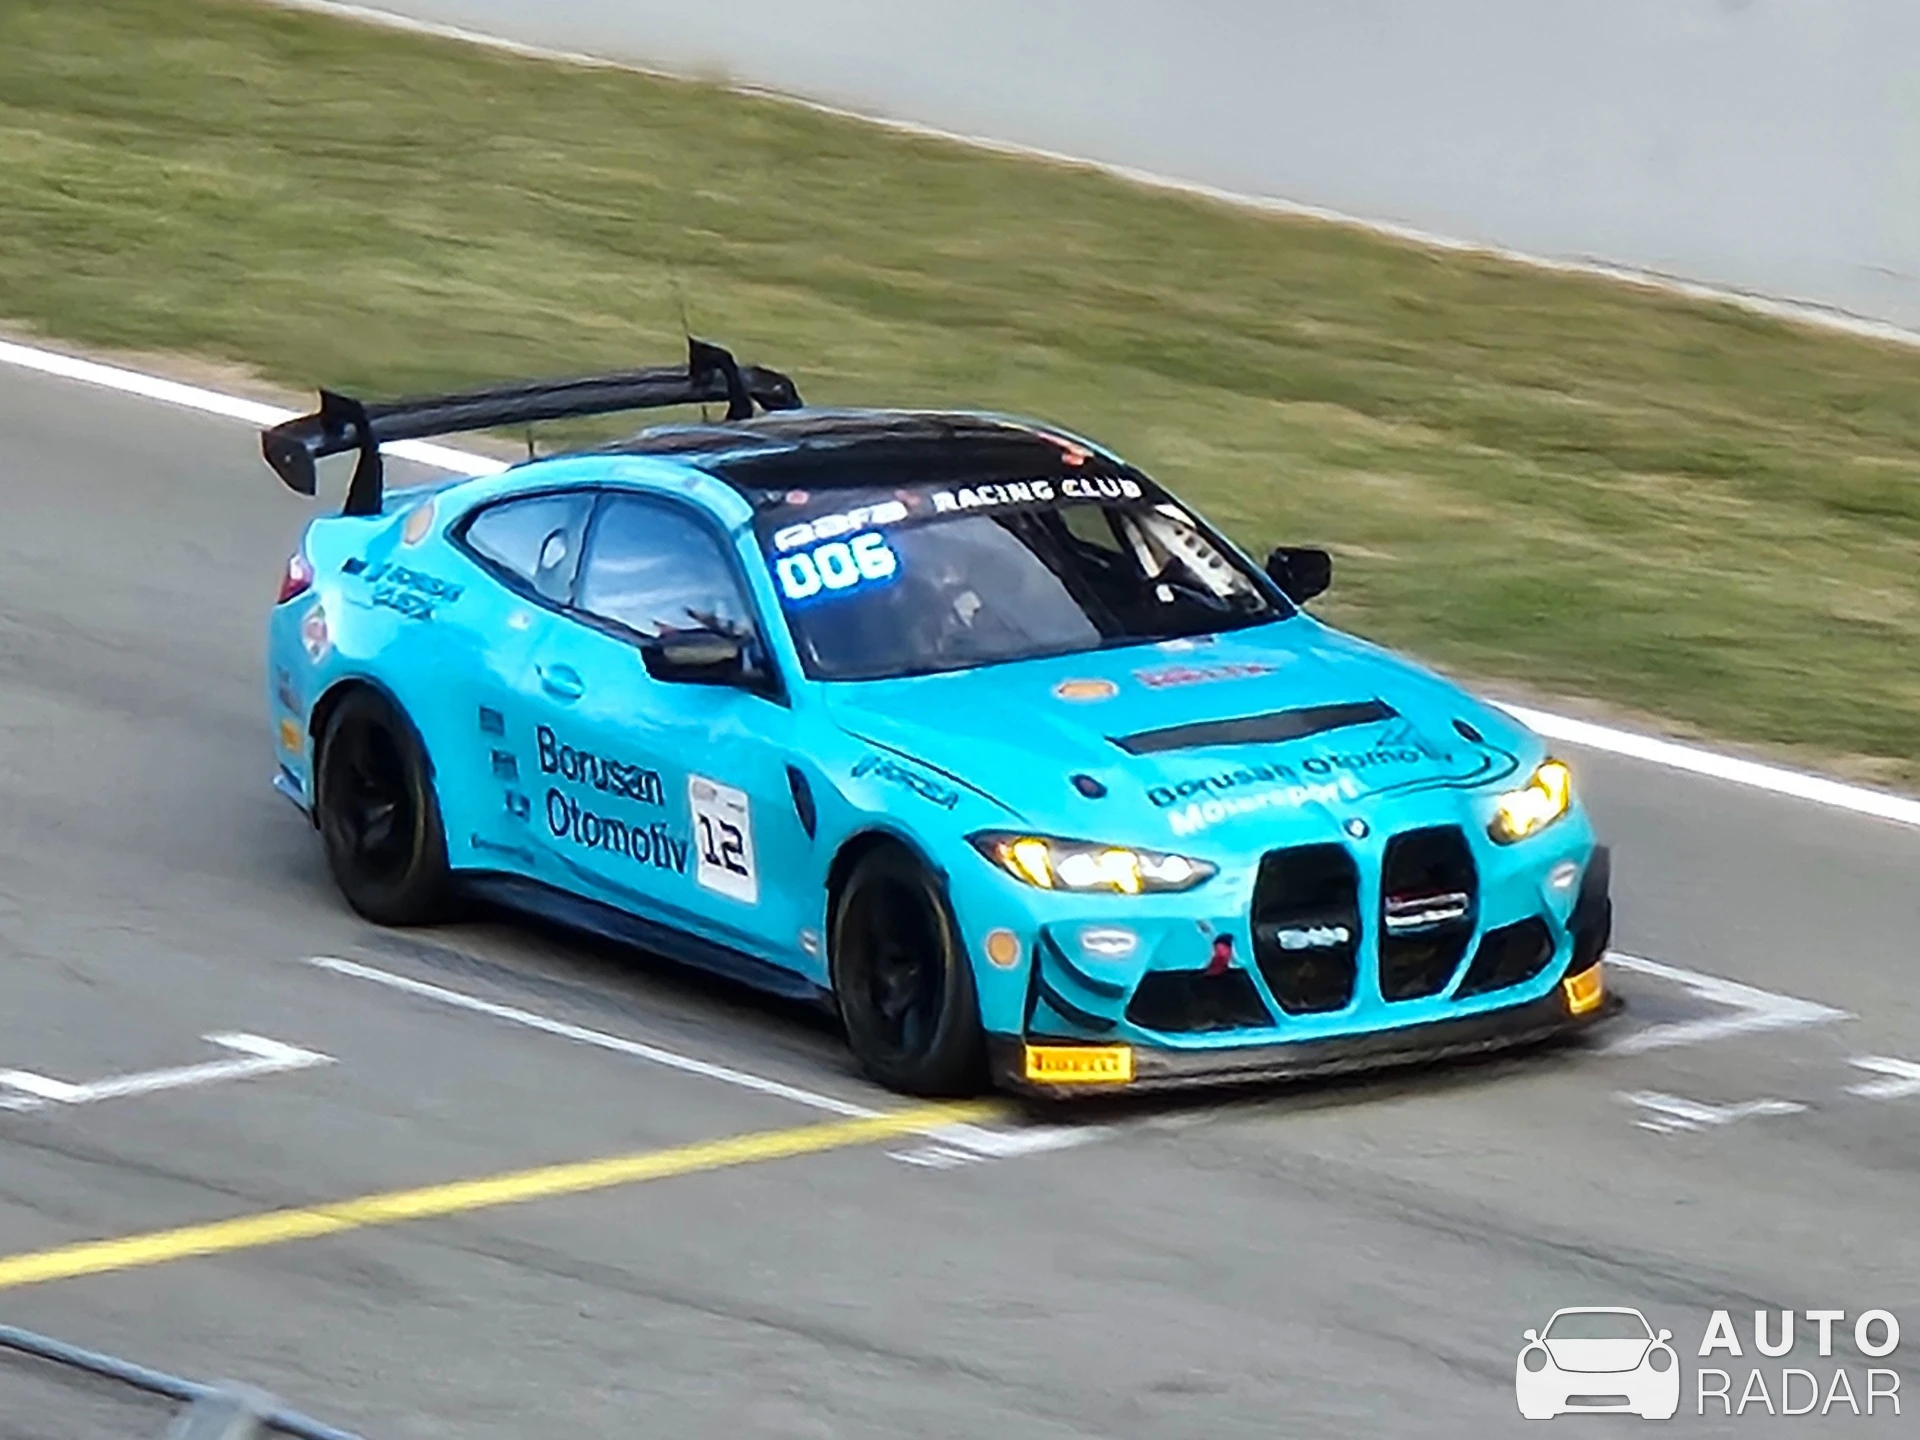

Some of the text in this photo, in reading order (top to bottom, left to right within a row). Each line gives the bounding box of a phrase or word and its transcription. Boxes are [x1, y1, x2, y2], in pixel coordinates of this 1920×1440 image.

[931, 480, 1055, 513] RACING
[1060, 477, 1143, 499] CLUB
[775, 532, 897, 600] 006
[536, 725, 665, 806] Borusan
[546, 787, 689, 875] Otomotiv
[698, 812, 749, 877] 12
